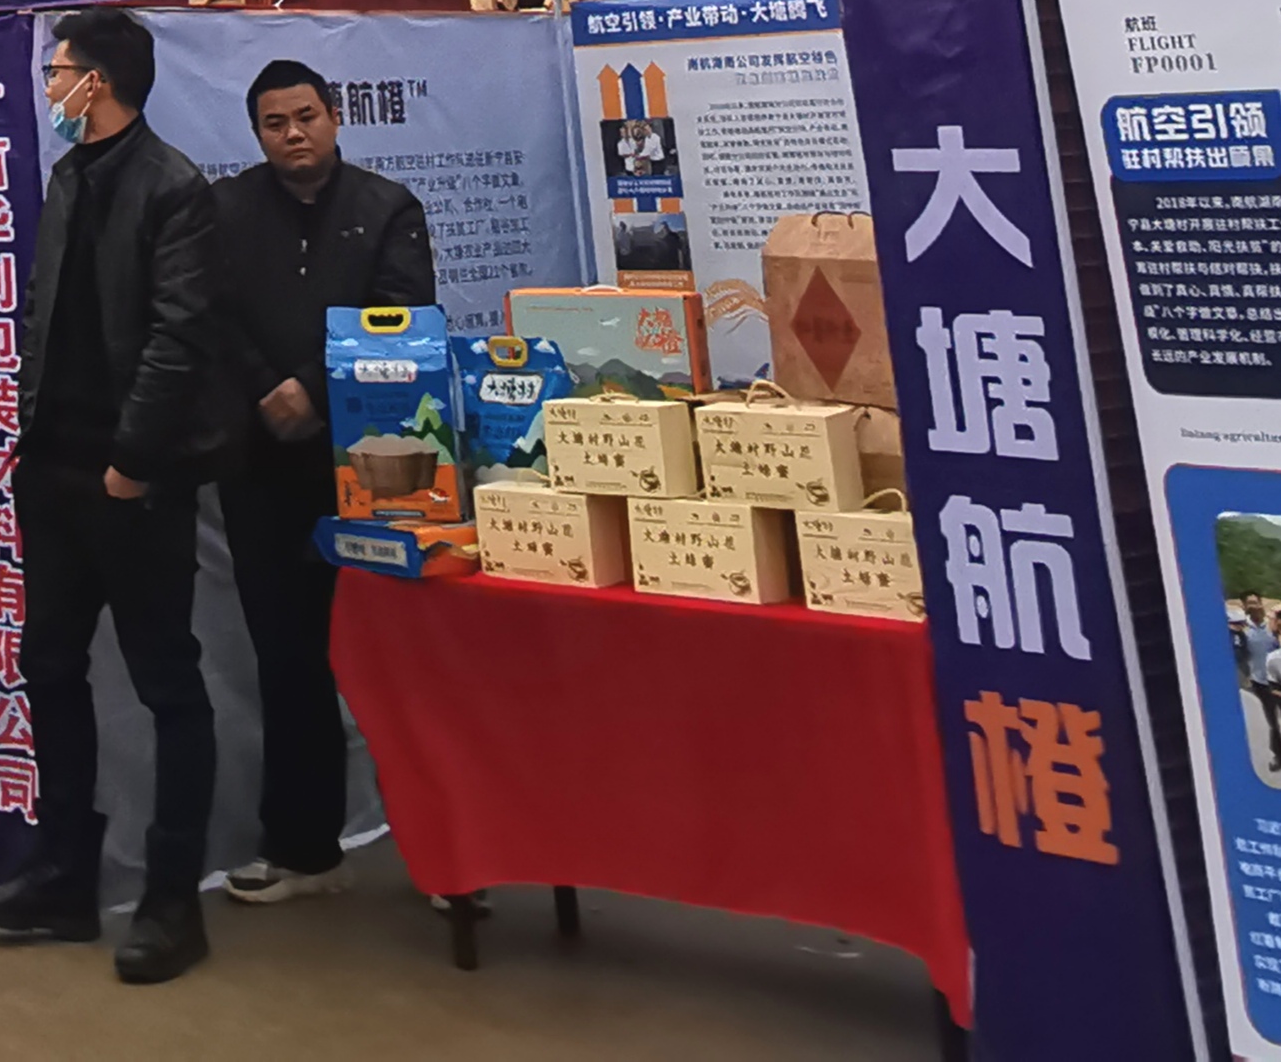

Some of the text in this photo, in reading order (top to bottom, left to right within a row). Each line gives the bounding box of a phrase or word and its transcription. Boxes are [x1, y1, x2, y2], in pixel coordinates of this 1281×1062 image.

[1124, 16, 1159, 33] 航班
[1127, 34, 1197, 52] FLIGHT
[1131, 53, 1218, 74] FP0001
[1116, 102, 1268, 142] 航空引领
[1120, 145, 1276, 170] 驻村帮扶出硕果
[581, 451, 626, 469] 土蜂蜜
[741, 460, 790, 480] 土蜂蜜
[892, 125, 1120, 866] 大塘航橙
[512, 540, 555, 558] 土蜂蜜
[668, 551, 715, 570] 土蜂蜜
[841, 569, 891, 588] 土蜂蜜
